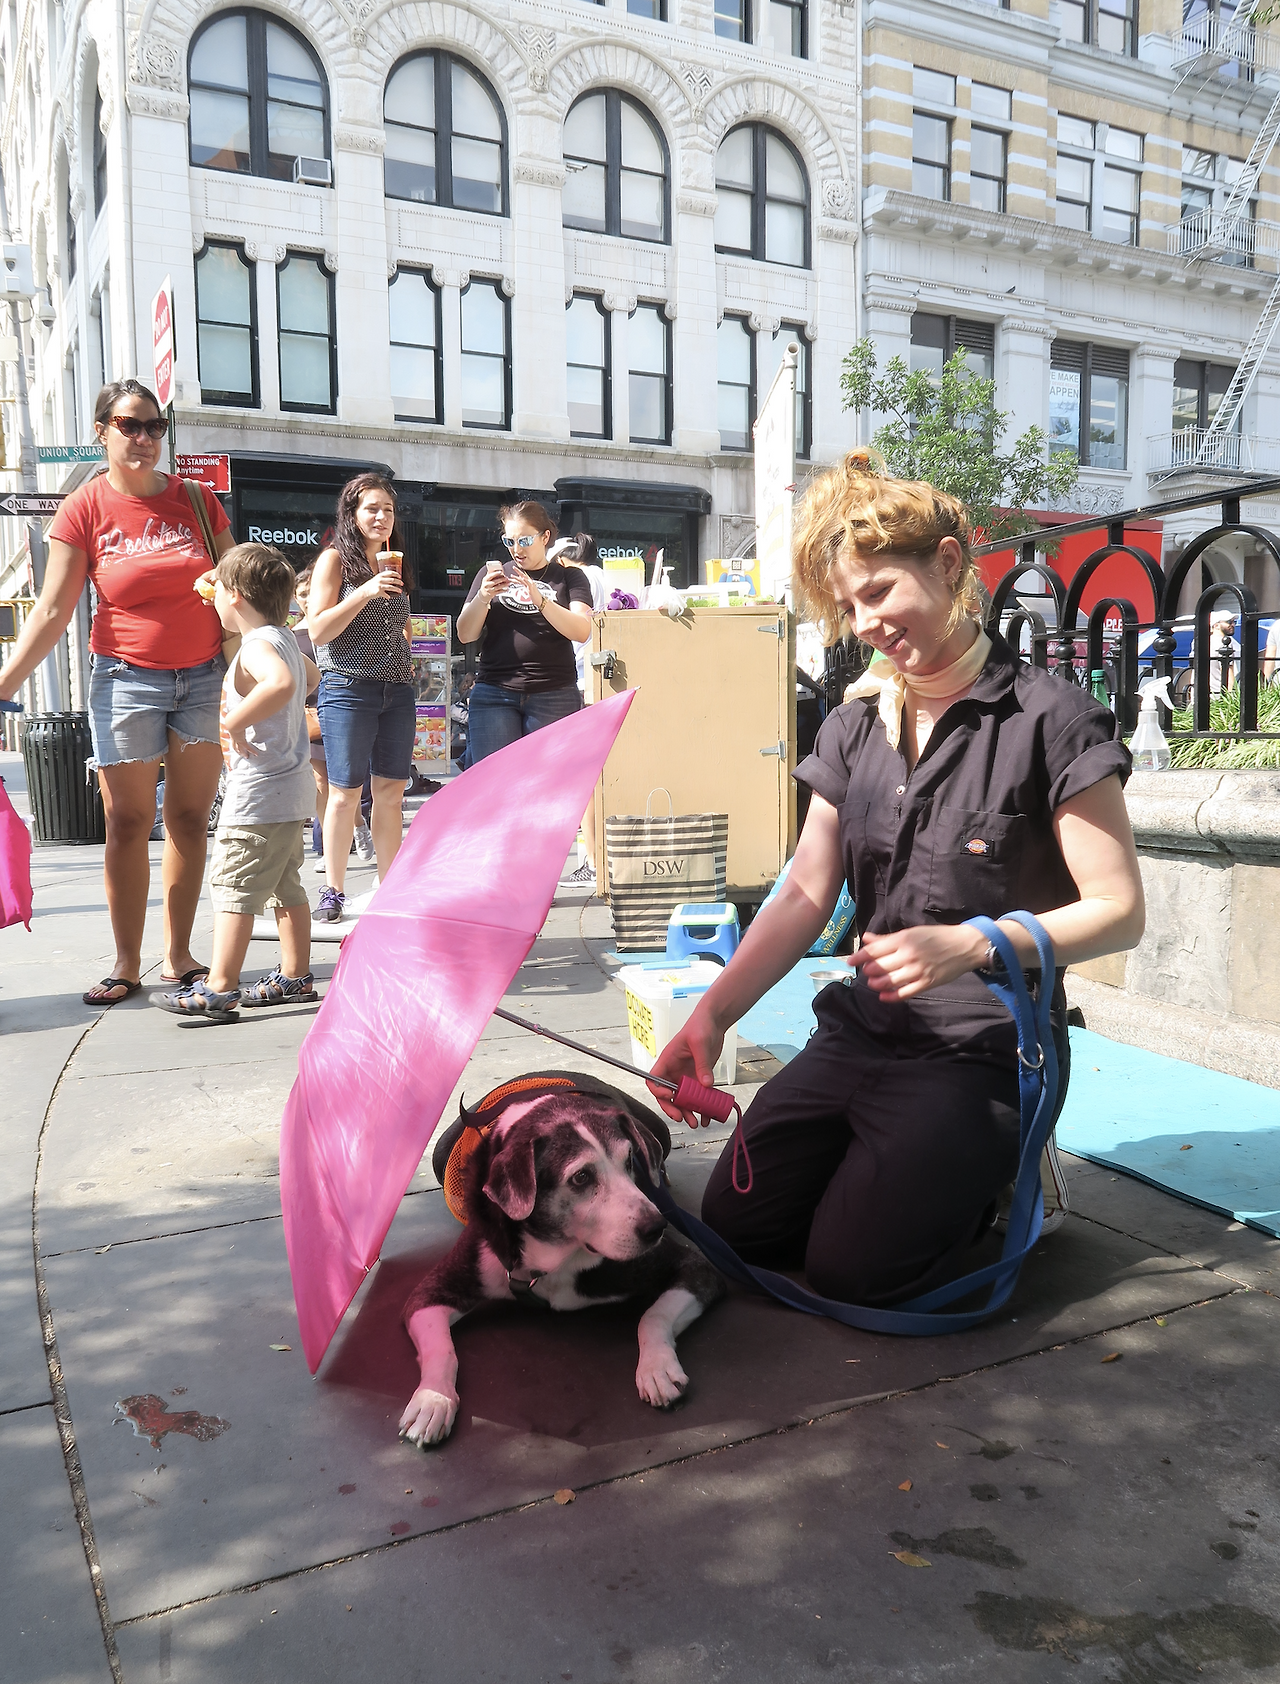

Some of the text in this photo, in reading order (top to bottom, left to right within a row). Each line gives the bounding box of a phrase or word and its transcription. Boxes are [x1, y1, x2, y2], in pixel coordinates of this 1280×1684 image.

[157, 357, 170, 388] ENTER
[1057, 372, 1079, 383] MAKE
[1050, 386, 1079, 398] APPEN
[40, 446, 105, 458] UNION SQUAR
[187, 458, 220, 466] STANDING
[177, 466, 204, 476] Anytime
[7, 500, 61, 510] ONE WAY
[248, 525, 319, 545] Reebok
[597, 545, 644, 561] eebok
[643, 860, 685, 876] DSW
[820, 914, 848, 955] WELLNESS
